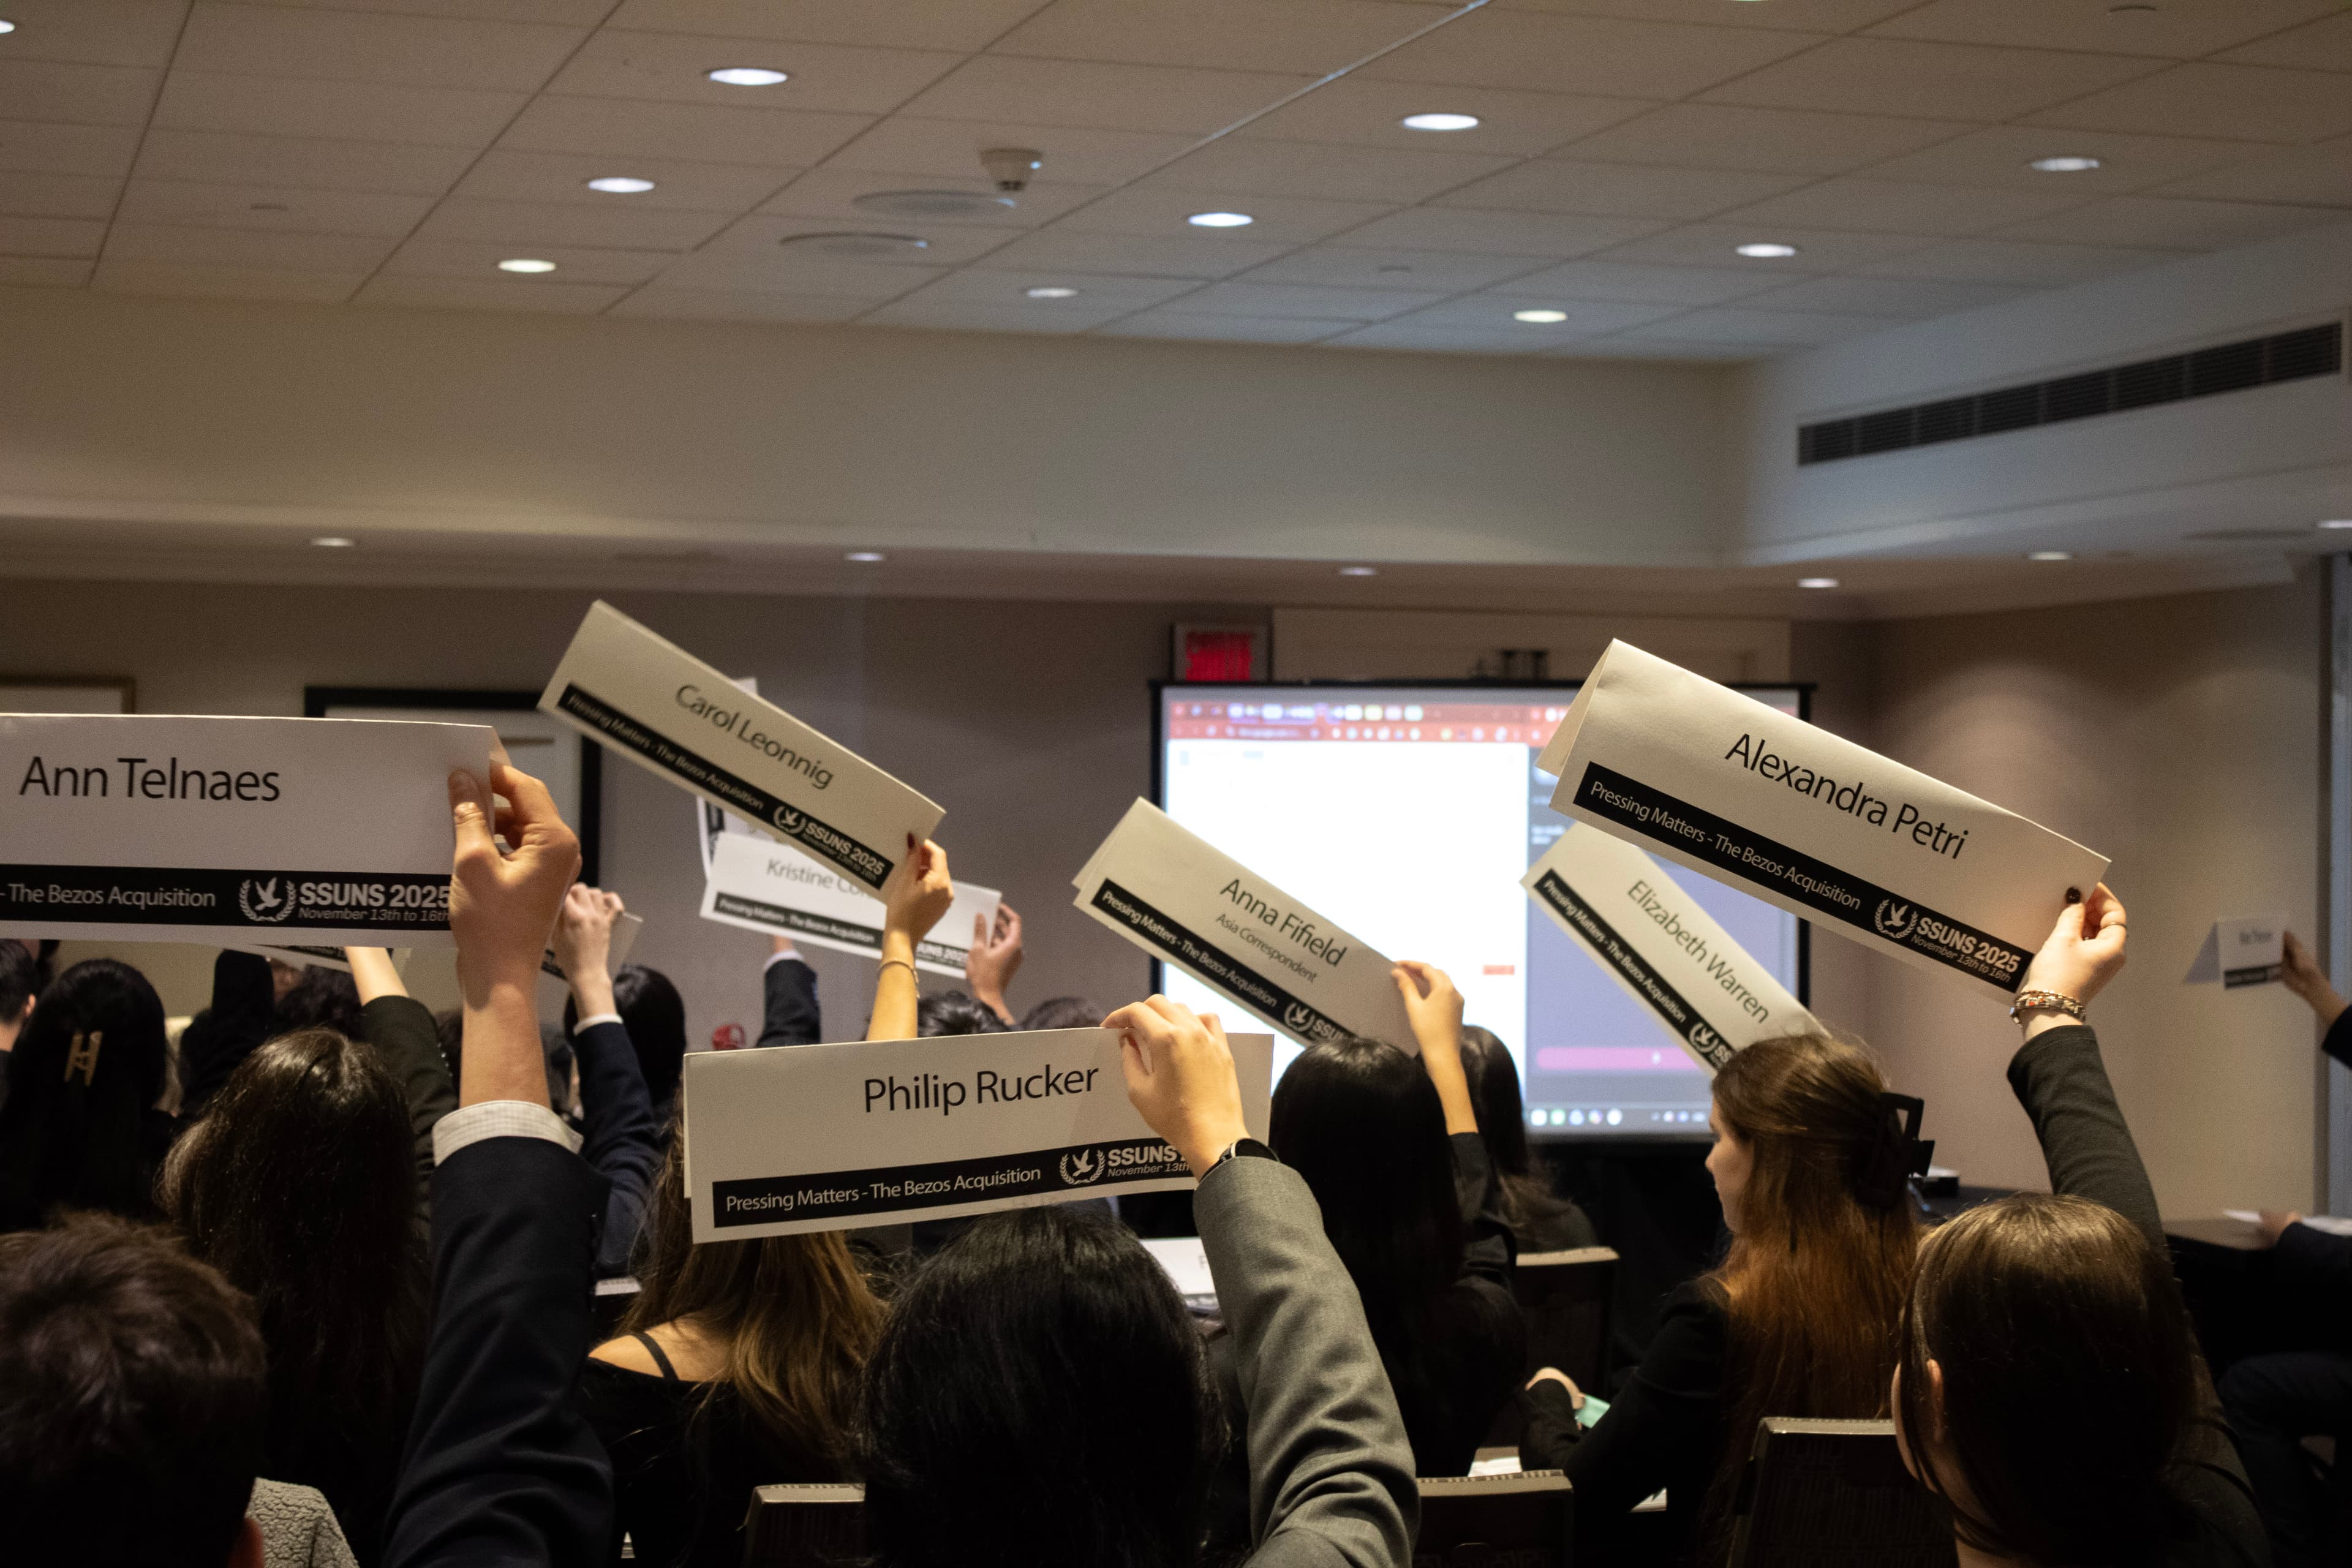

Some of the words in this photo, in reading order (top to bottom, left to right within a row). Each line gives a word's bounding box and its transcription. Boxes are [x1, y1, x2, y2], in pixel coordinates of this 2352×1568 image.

[676, 684, 741, 732] Carol
[737, 719, 834, 790] Leonnig
[19, 756, 108, 797] Ann
[117, 757, 280, 802] Telnaes
[1724, 733, 1888, 827] Alexandra
[1892, 803, 1969, 859] Petri
[805, 822, 852, 854] SSUNS
[850, 847, 886, 875] 2025
[1590, 780, 1651, 821] Pressing
[1656, 808, 1706, 842] Matters
[1715, 834, 1741, 858] The
[1741, 846, 1784, 876] Bezos
[1783, 866, 1861, 910] Acquisition
[7, 883, 45, 903] The
[48, 884, 104, 905] Bezos
[107, 886, 216, 910] Acquisition
[299, 882, 385, 907] SSUNS
[389, 884, 450, 908] 2025
[766, 859, 834, 889] Kristine
[298, 907, 367, 920] November
[369, 908, 401, 921] 13th
[403, 910, 418, 921] to
[1219, 878, 1279, 927] Anna
[1279, 913, 1348, 968] Fifield
[1102, 891, 1142, 924] Pressing
[1140, 914, 1177, 944] Matters
[1182, 940, 1200, 959] The
[1198, 951, 1227, 976] Bezos
[1225, 970, 1277, 1007] Acquisition
[1215, 913, 1240, 934] Asia
[1239, 928, 1319, 984] Correspondent
[1544, 879, 1580, 916] Pressing
[1574, 910, 1605, 943] Matters
[1607, 940, 1625, 960] The
[1620, 955, 1646, 982] Bezos
[1642, 978, 1686, 1023] Acquisition
[1627, 880, 1708, 963] Elizabeth
[1706, 954, 1770, 1025] Warren
[1910, 933, 1958, 959] November
[1956, 954, 1980, 969] 13th
[1978, 963, 1990, 973] to
[1988, 967, 2011, 982] 16th
[1917, 917, 1977, 954] SSUNS
[1973, 941, 2021, 973] 2025
[1313, 1019, 1343, 1040] SSU
[864, 1073, 967, 1116] Philip
[977, 1064, 1099, 1104] Rucker
[1107, 1145, 1177, 1167] SSUNS
[1107, 1164, 1163, 1177] November
[1164, 1162, 1190, 1172] 13th
[726, 1193, 794, 1212] Pressing
[797, 1188, 859, 1206] Matters
[869, 1182, 902, 1199] The
[904, 1180, 951, 1196] Bezos
[953, 1168, 1041, 1191] Acquisition
